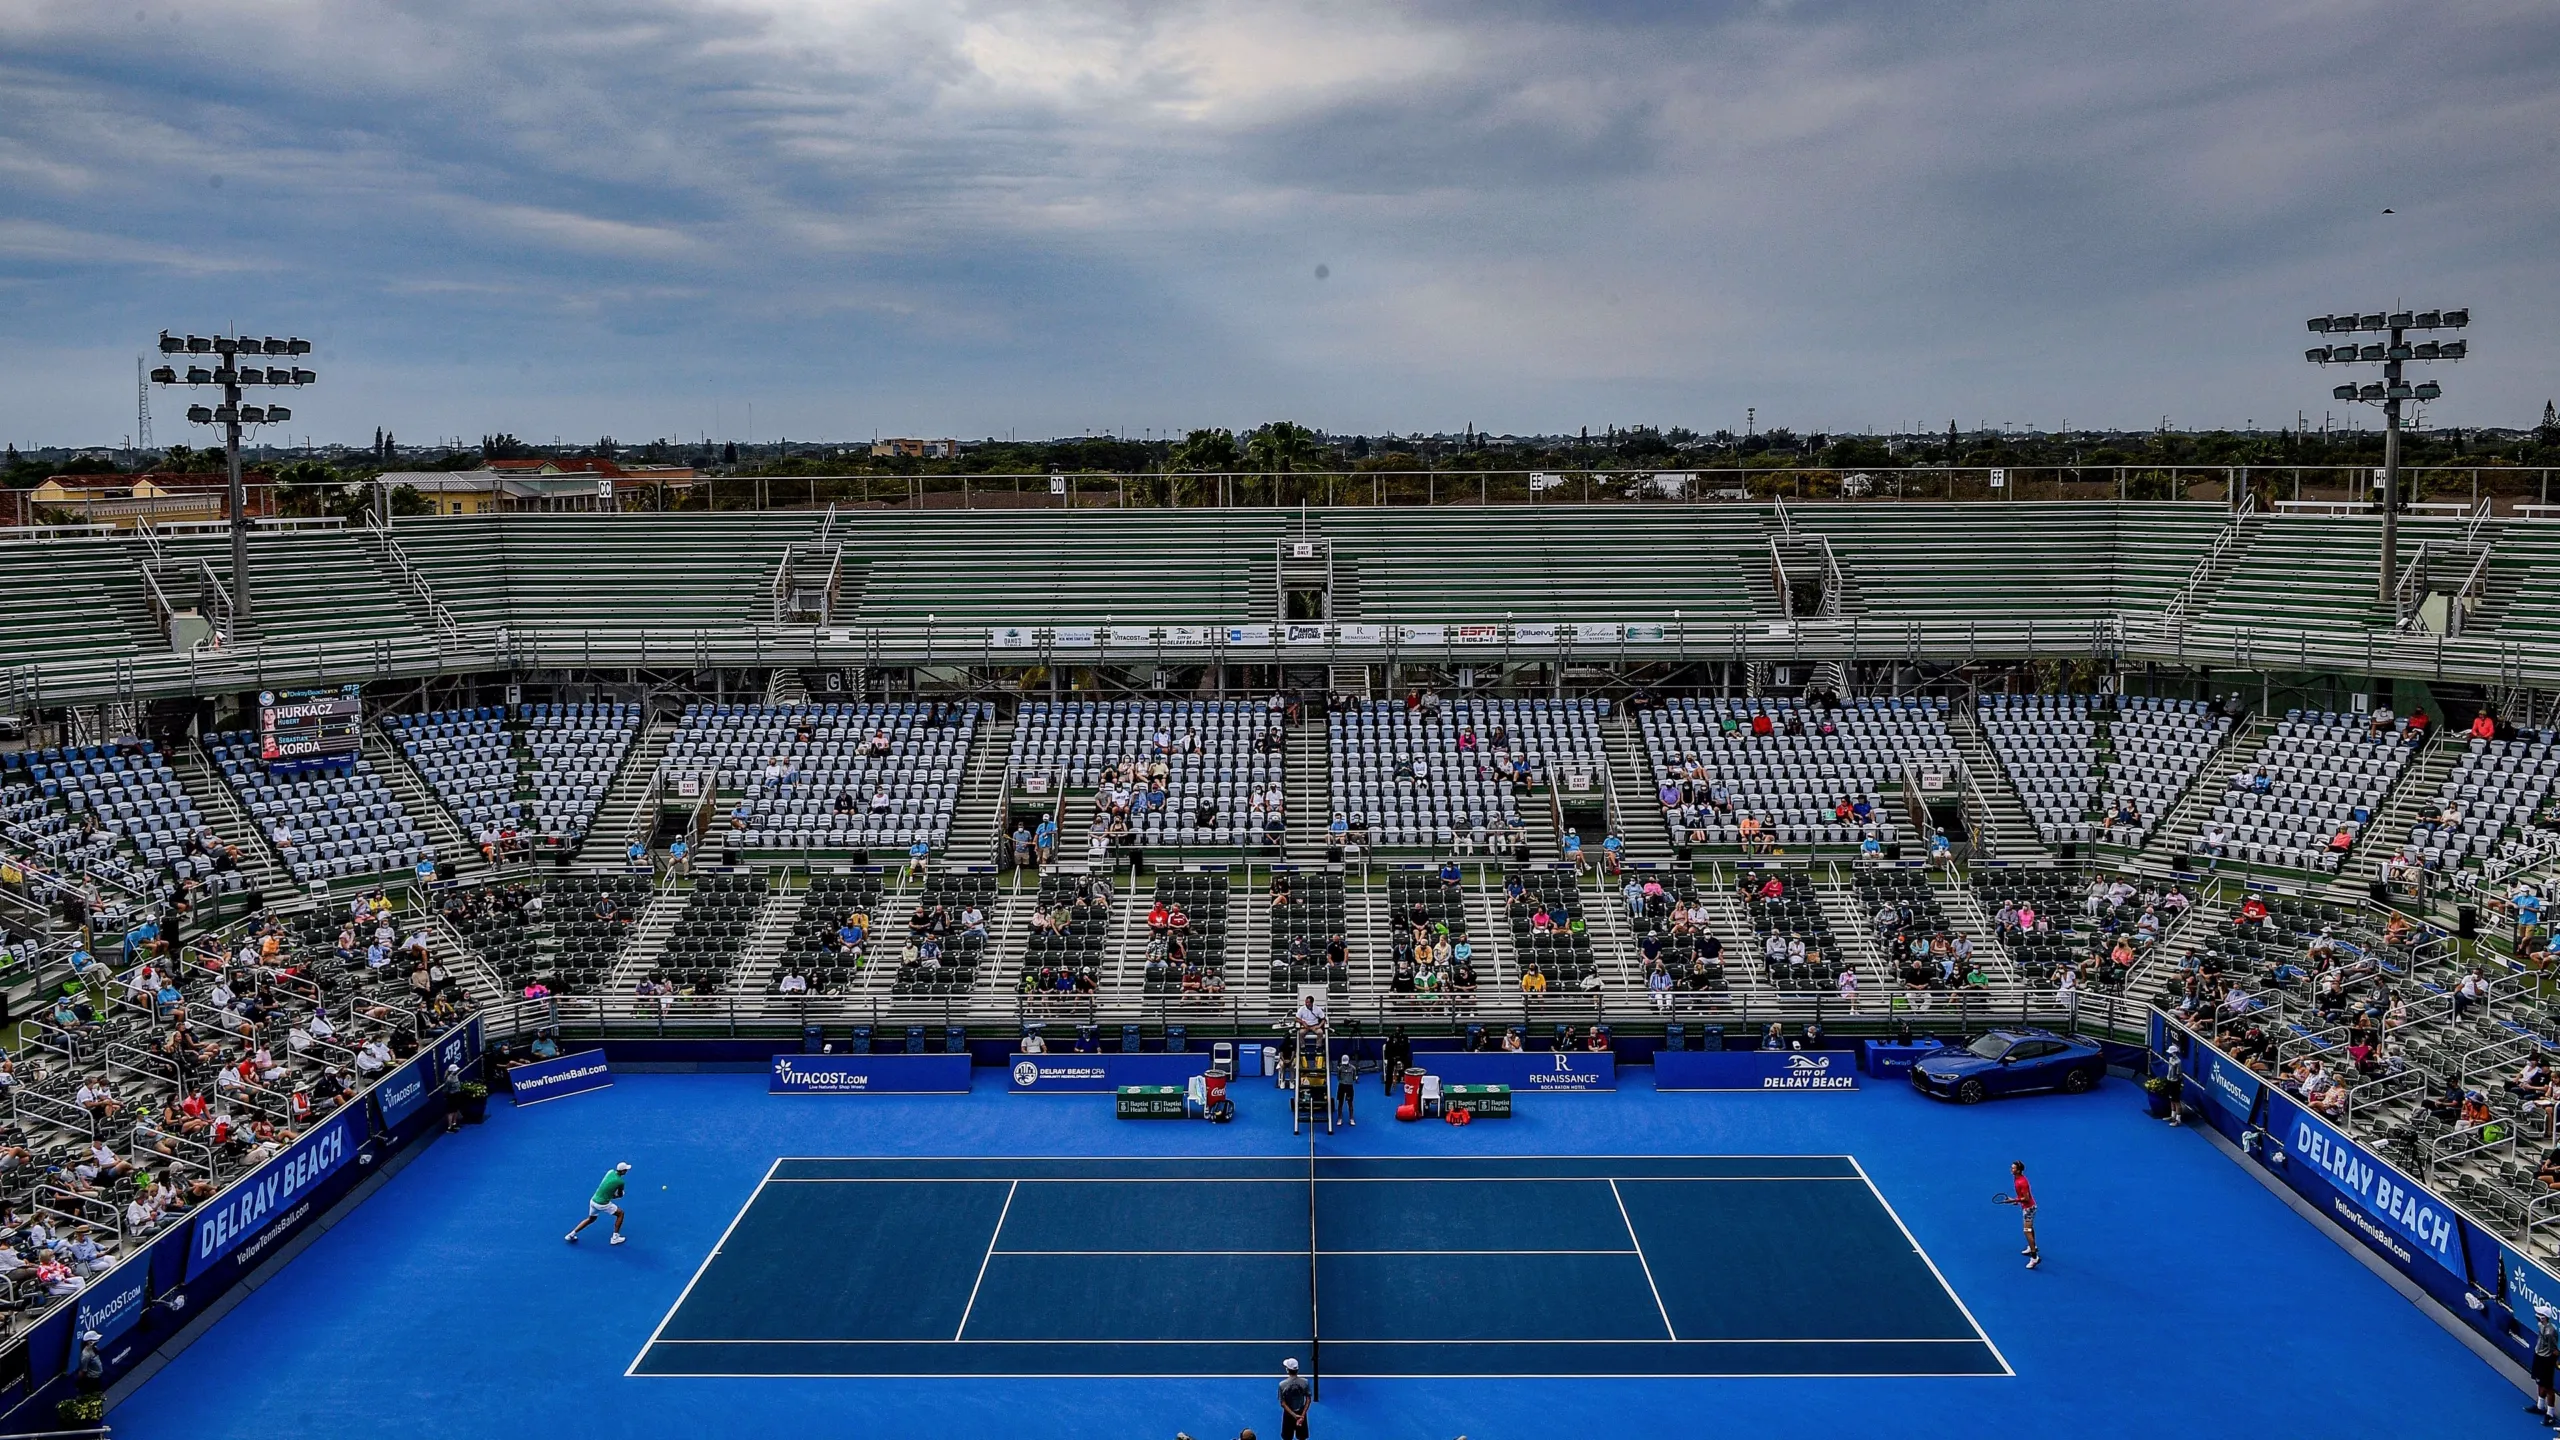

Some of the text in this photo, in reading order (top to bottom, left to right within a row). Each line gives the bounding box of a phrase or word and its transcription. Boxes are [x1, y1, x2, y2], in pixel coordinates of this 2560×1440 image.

[1052, 478, 1063, 492] DD
[1532, 474, 1543, 488] EE
[1992, 471, 2002, 485] FF
[600, 482, 610, 496] CC
[1460, 627, 1495, 635] ESPN
[829, 674, 839, 690] G
[1154, 672, 1165, 689] H
[1778, 668, 1786, 684] J
[2101, 677, 2112, 694] K
[508, 686, 517, 702] F
[2354, 694, 2364, 712] L
[277, 704, 333, 719] HURKACZ
[350, 715, 359, 723] 15
[351, 726, 359, 734] 15
[279, 742, 320, 755] KORDA
[444, 1039, 460, 1063] ATP
[1555, 1054, 1573, 1071] R
[515, 1064, 608, 1090] YellowTennisBall.com
[1530, 1075, 1597, 1083] RENAISSANCE
[1764, 1078, 1852, 1087] DELRAY BEACH
[201, 1126, 343, 1259] DELRAY BEACH
[2297, 1122, 2451, 1254] DELRAY BEACH
[237, 1203, 310, 1265] YellowTennisBall.com
[2334, 1197, 2411, 1264] YellowTennisBall.com
